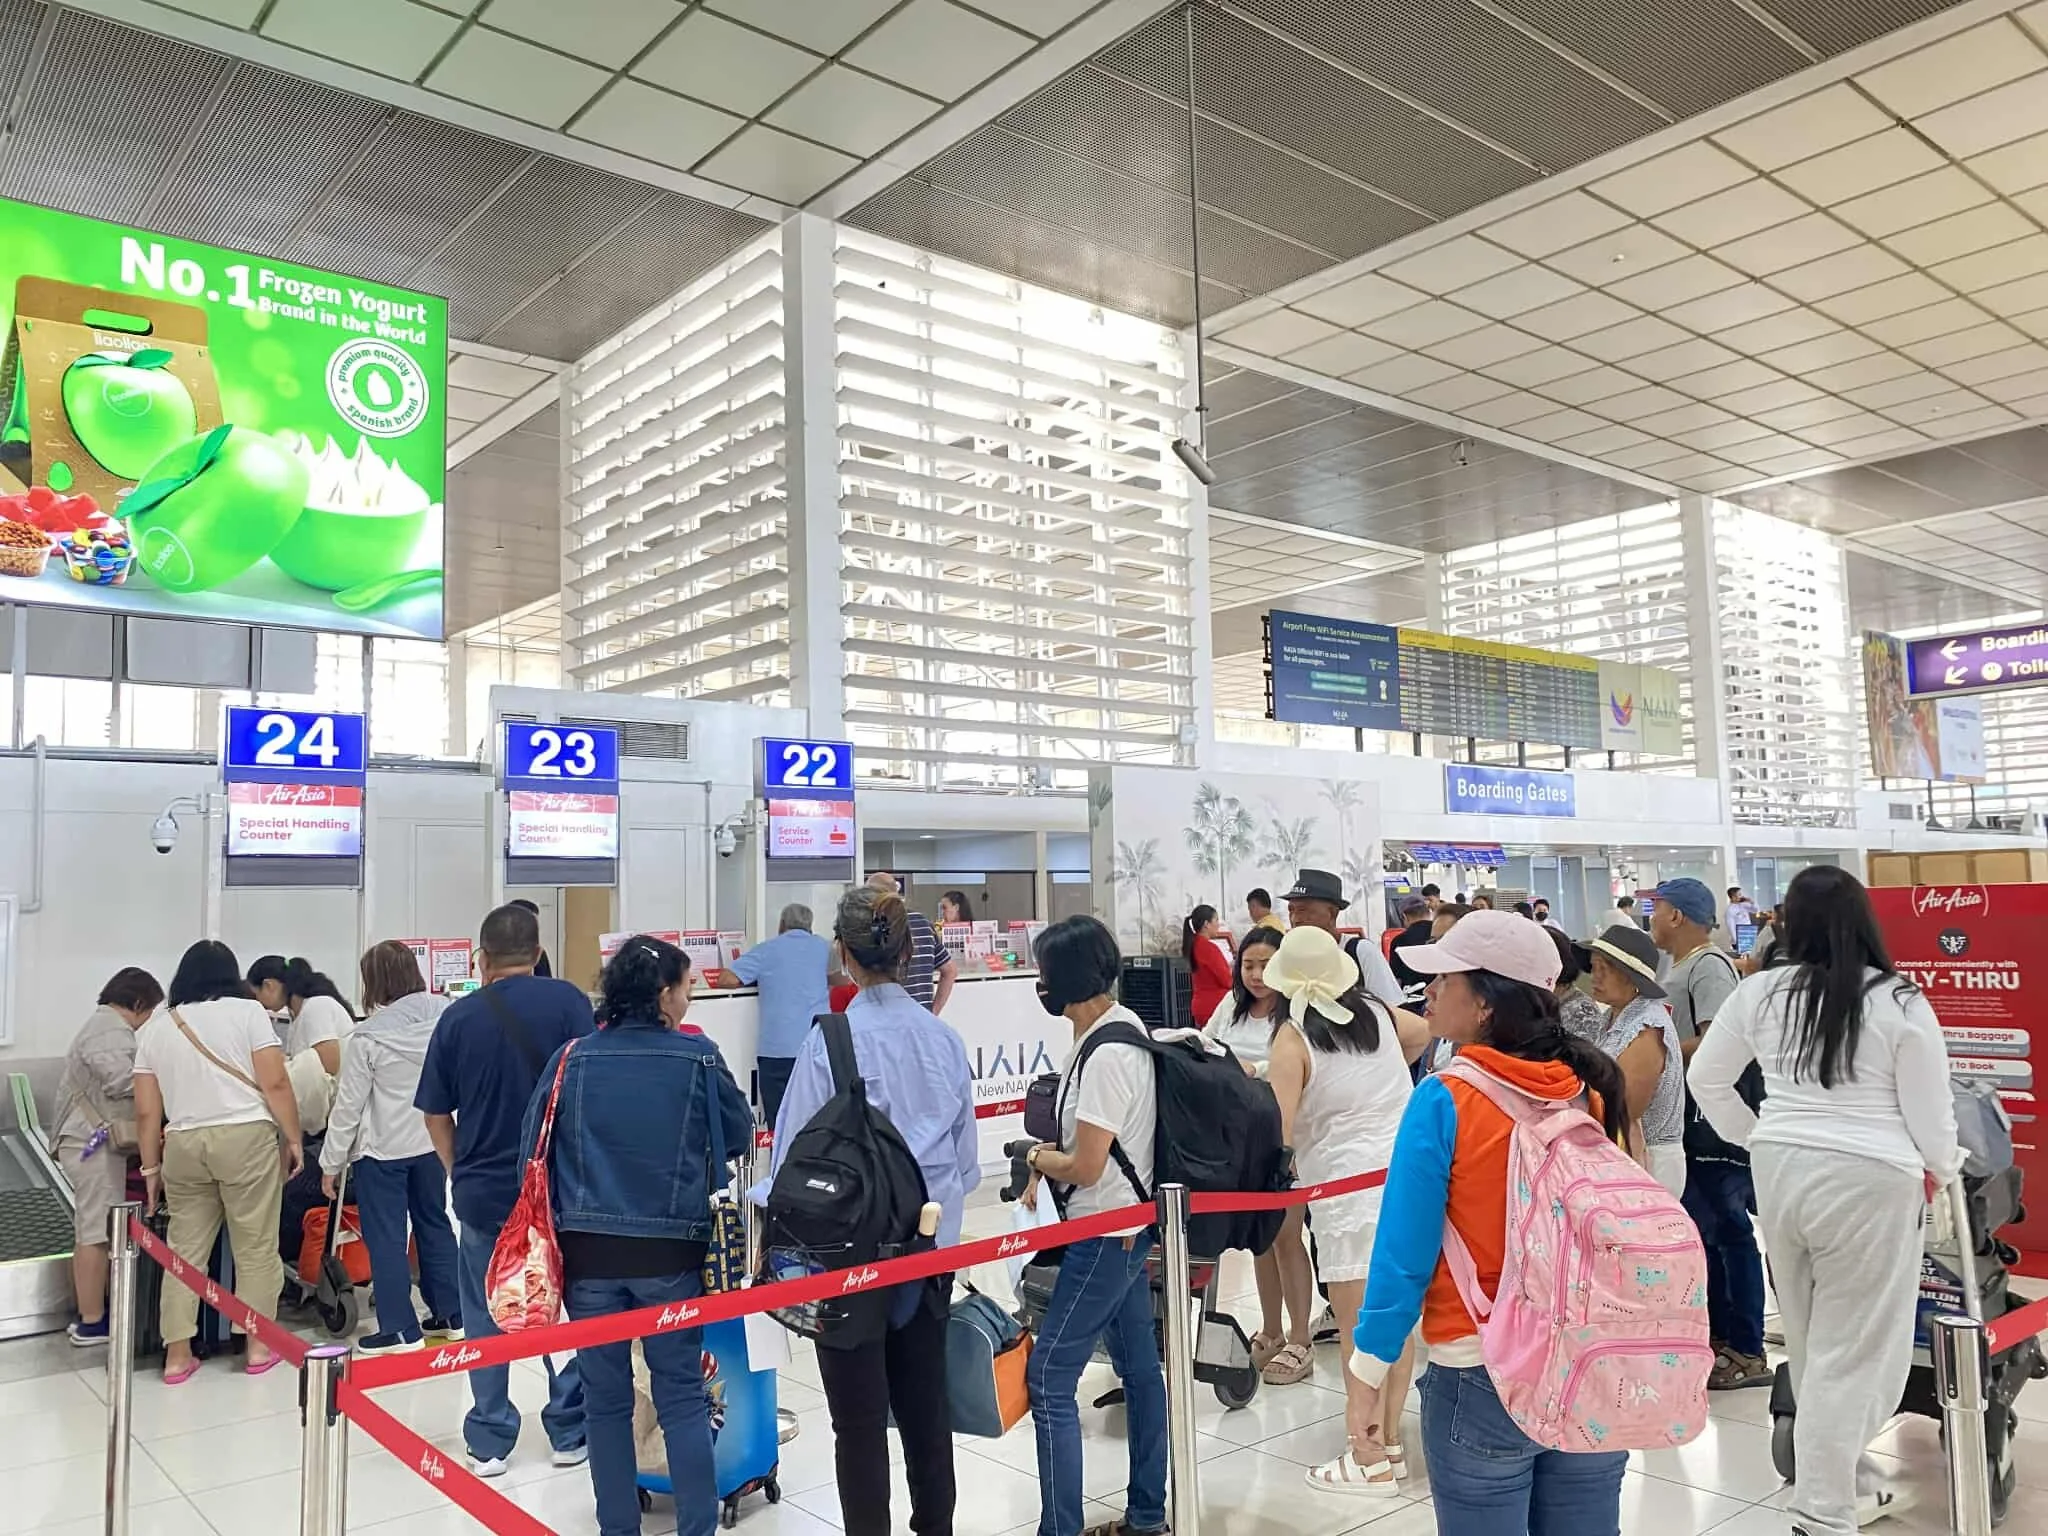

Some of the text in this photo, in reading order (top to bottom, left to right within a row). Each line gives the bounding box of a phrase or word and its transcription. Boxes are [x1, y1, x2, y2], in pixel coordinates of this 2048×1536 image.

[258, 268, 427, 325] Frozen Yogurt
[257, 295, 427, 346] Brand in the World
[338, 349, 411, 383] premium quality
[346, 397, 420, 428] spanish brand
[255, 713, 340, 767] 24
[528, 729, 597, 776] 23
[782, 744, 837, 786] 22
[1457, 778, 1567, 804] Boarding Gates
[239, 817, 350, 832] Special Handling
[518, 822, 609, 836] Special Handling
[777, 825, 810, 836] Service
[239, 829, 293, 841] Counter
[778, 835, 814, 845] Counter
[1934, 960, 1995, 969] conveniently
[1996, 960, 2018, 968] with
[1967, 1031, 2014, 1041] Baggage
[1969, 1062, 1996, 1070] Book
[977, 1084, 1005, 1097] New
